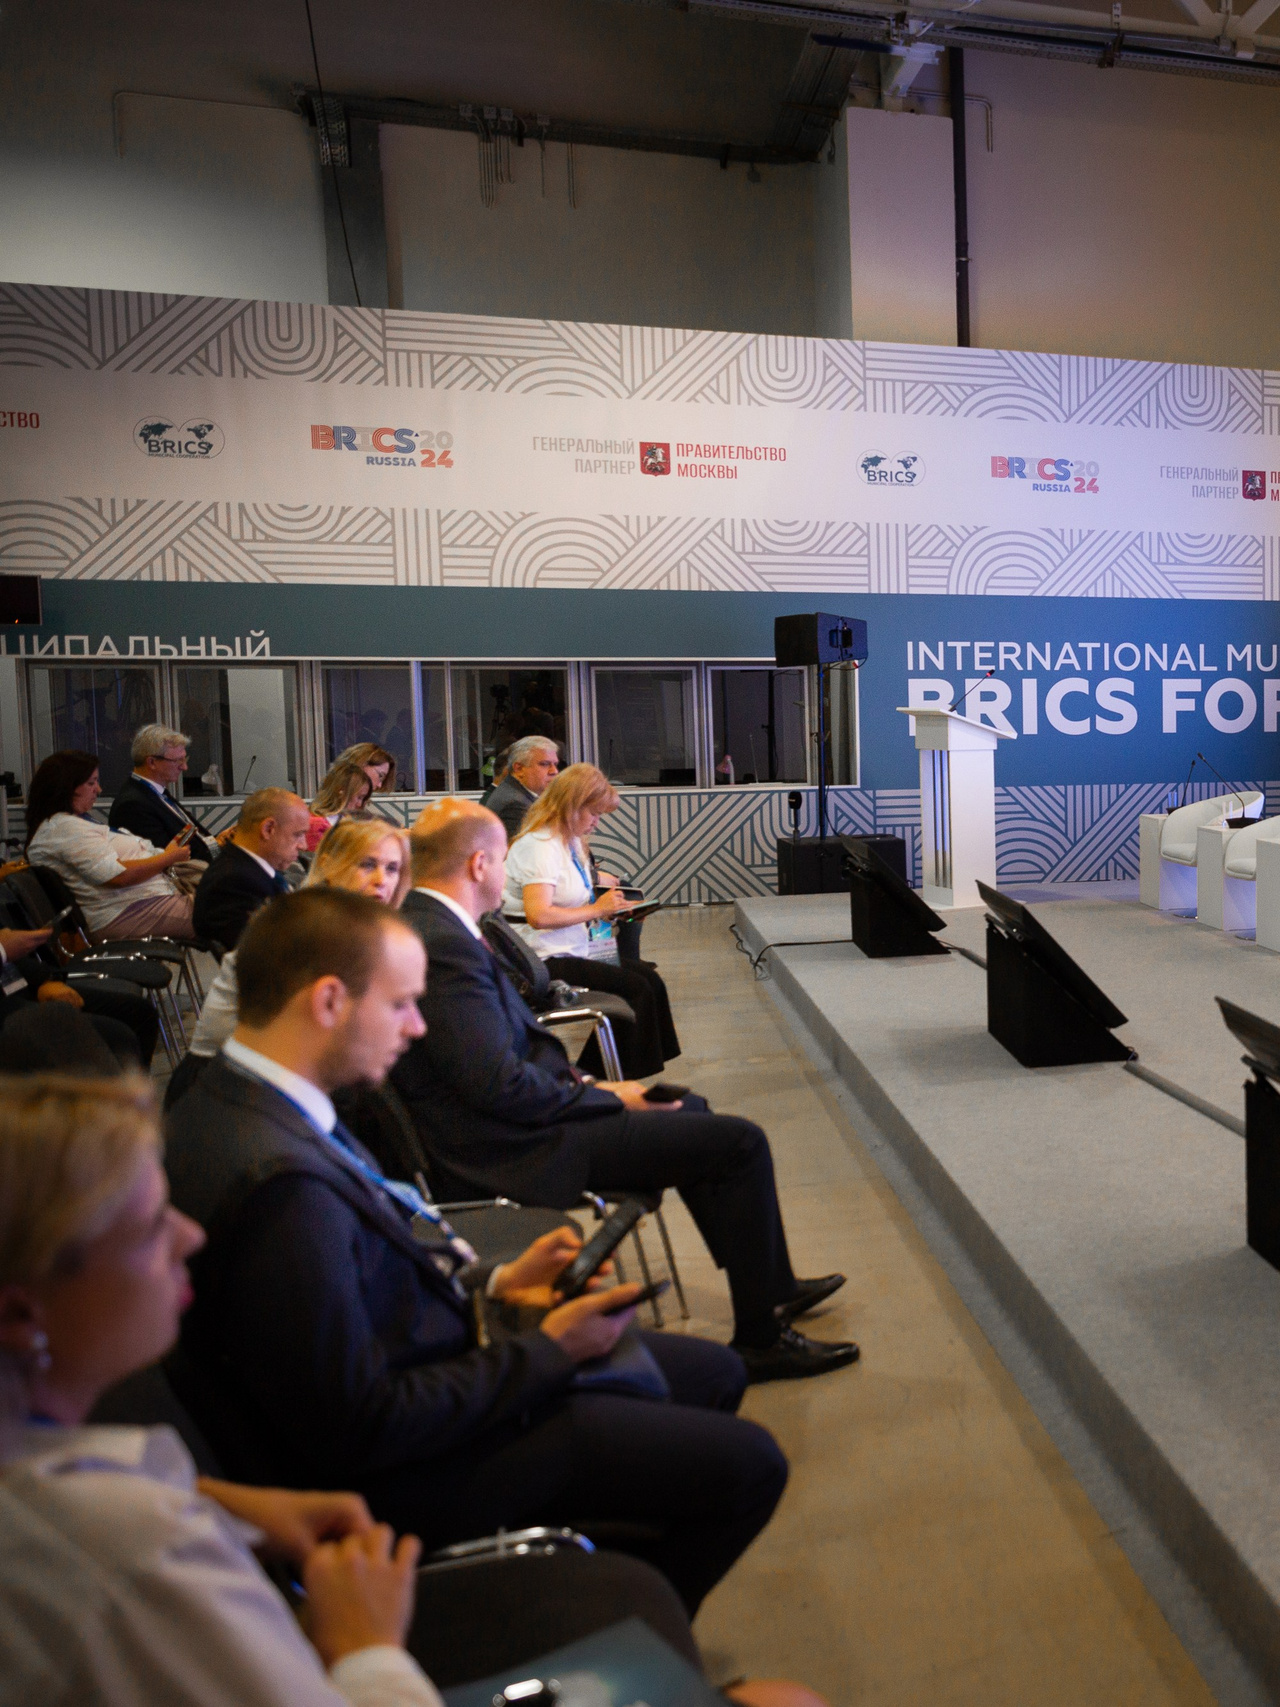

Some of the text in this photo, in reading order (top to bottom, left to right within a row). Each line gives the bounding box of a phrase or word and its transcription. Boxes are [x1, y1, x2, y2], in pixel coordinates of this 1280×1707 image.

[148, 440, 209, 455] BRICS
[310, 424, 454, 454] BRICS 20
[532, 436, 635, 455] ГЕНЕРАЛЬНЫЙ
[366, 449, 454, 469] RUSSIA 24
[676, 443, 787, 462] ПРАВИТЕЛЬСТВО
[574, 458, 636, 475] ПАРТНЕР
[677, 463, 738, 479] МОСКВЫ
[990, 455, 1100, 482] BRICS 20
[1160, 465, 1239, 482] ГЕНЕРАЛЬНЫЙ
[867, 470, 914, 483] BRICS
[1032, 477, 1100, 494] RUSSIA 24
[1191, 485, 1239, 499] ПАРТНЕР
[907, 641, 1218, 672] INTERNATIONAL
[908, 677, 1138, 737] BRICS
